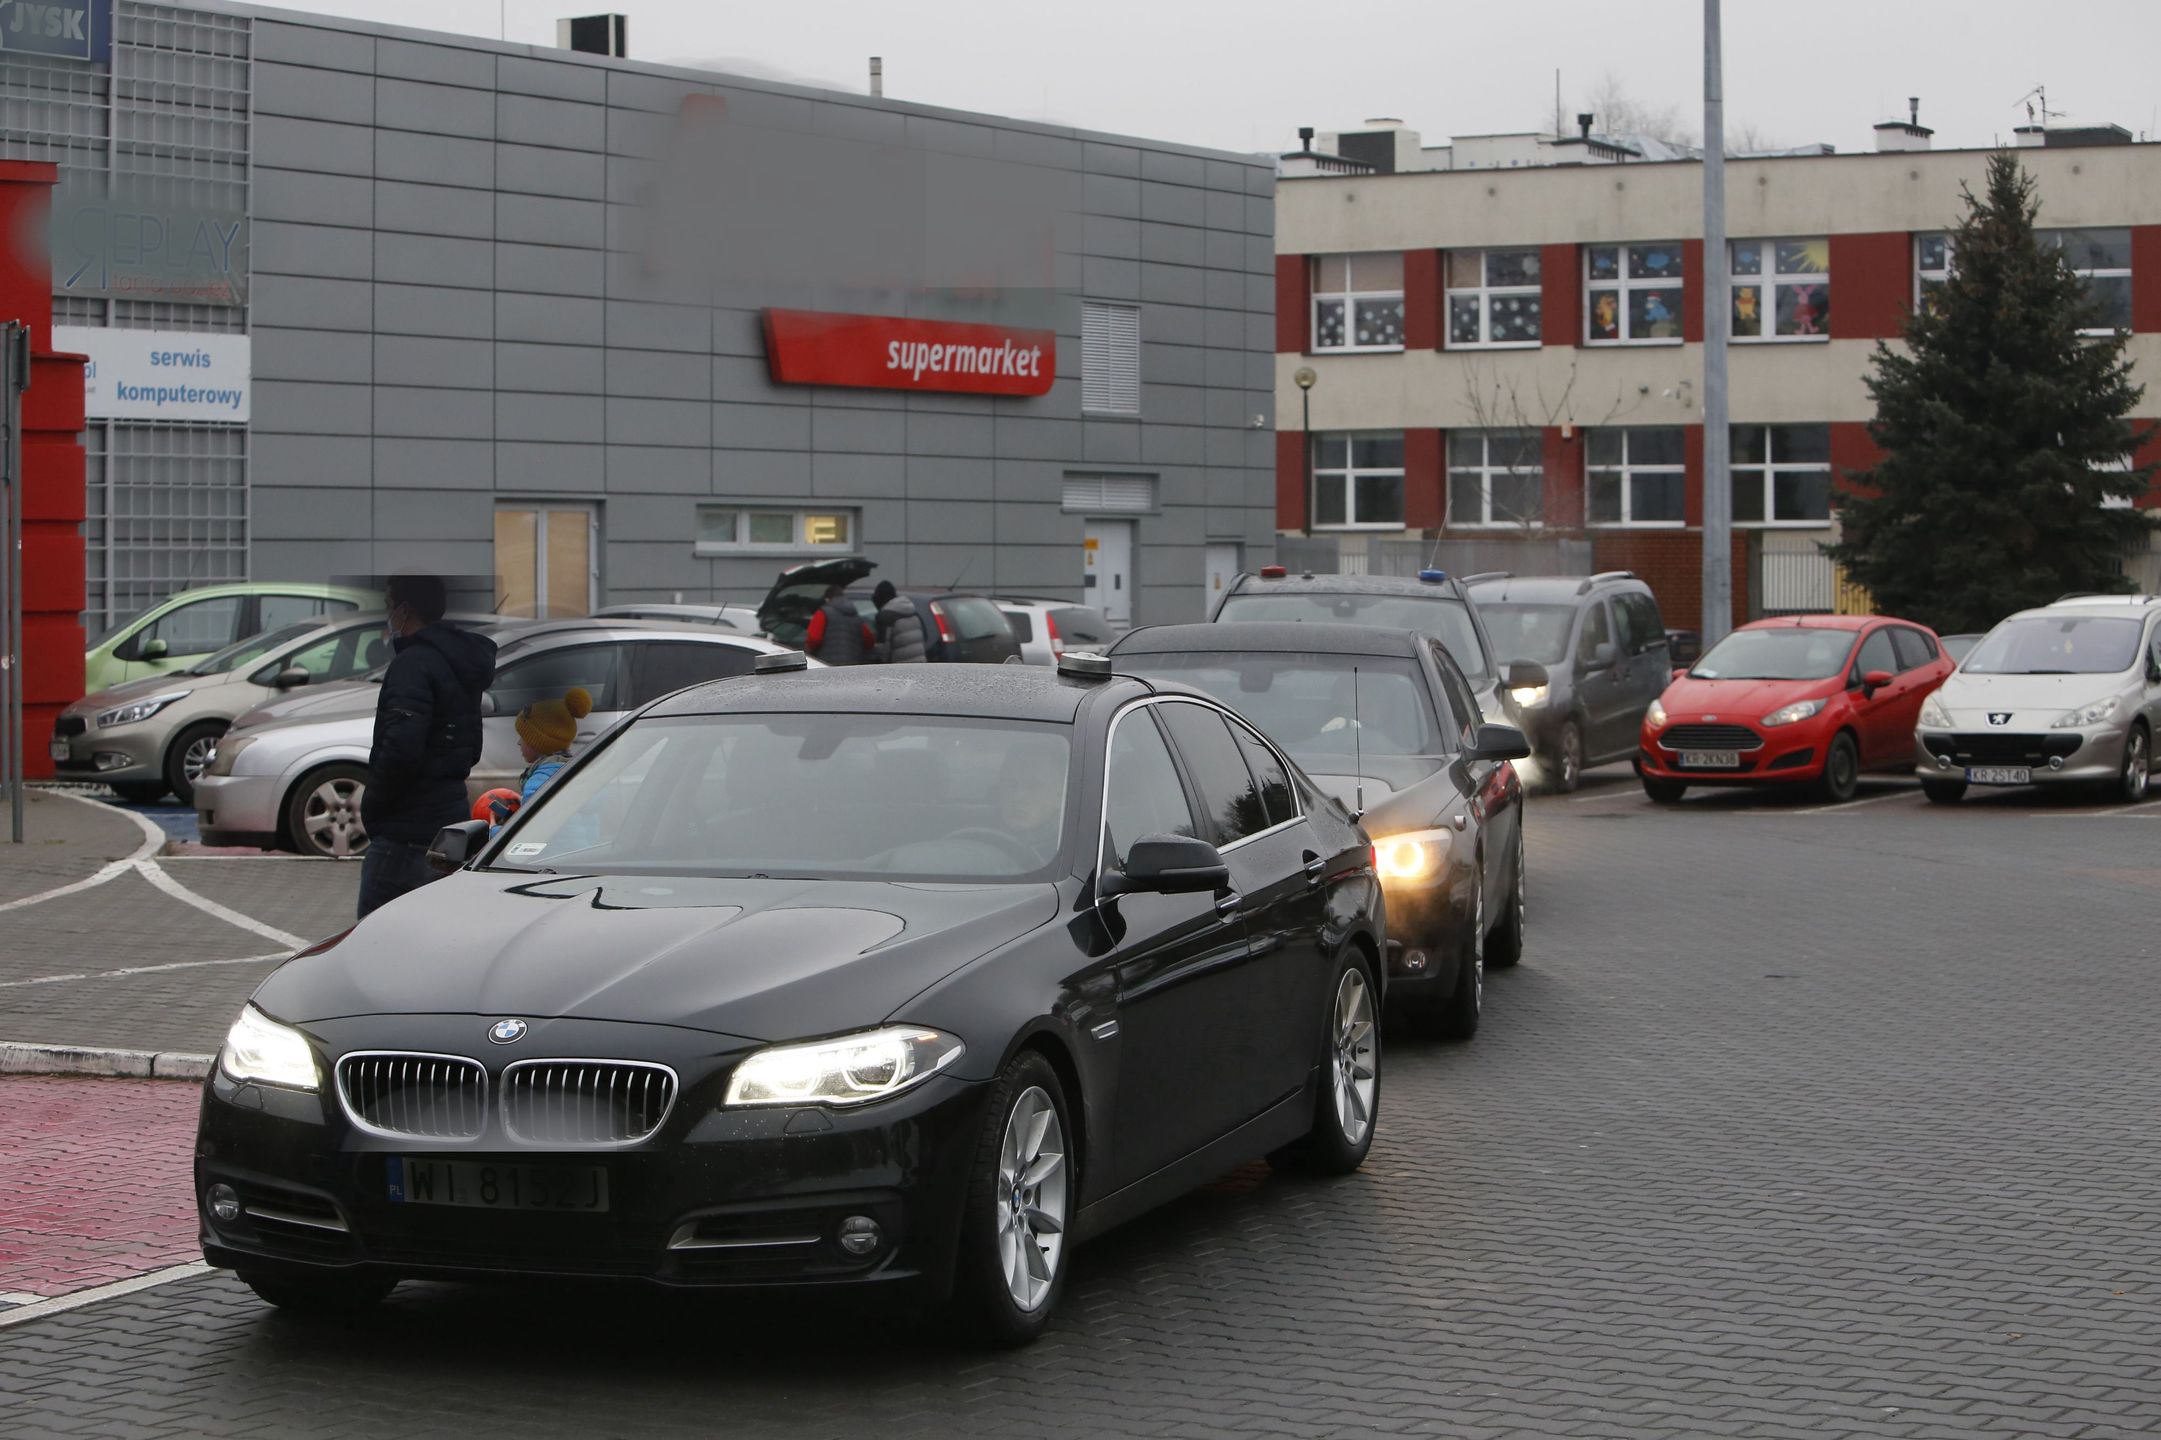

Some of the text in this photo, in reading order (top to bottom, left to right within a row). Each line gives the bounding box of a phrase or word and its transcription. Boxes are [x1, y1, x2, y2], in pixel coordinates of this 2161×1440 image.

[9, 2, 85, 40] JYSK
[150, 349, 211, 368] serwis
[887, 338, 1041, 382] supermarket
[117, 381, 242, 410] komputerowy
[1973, 768, 1988, 782] KR
